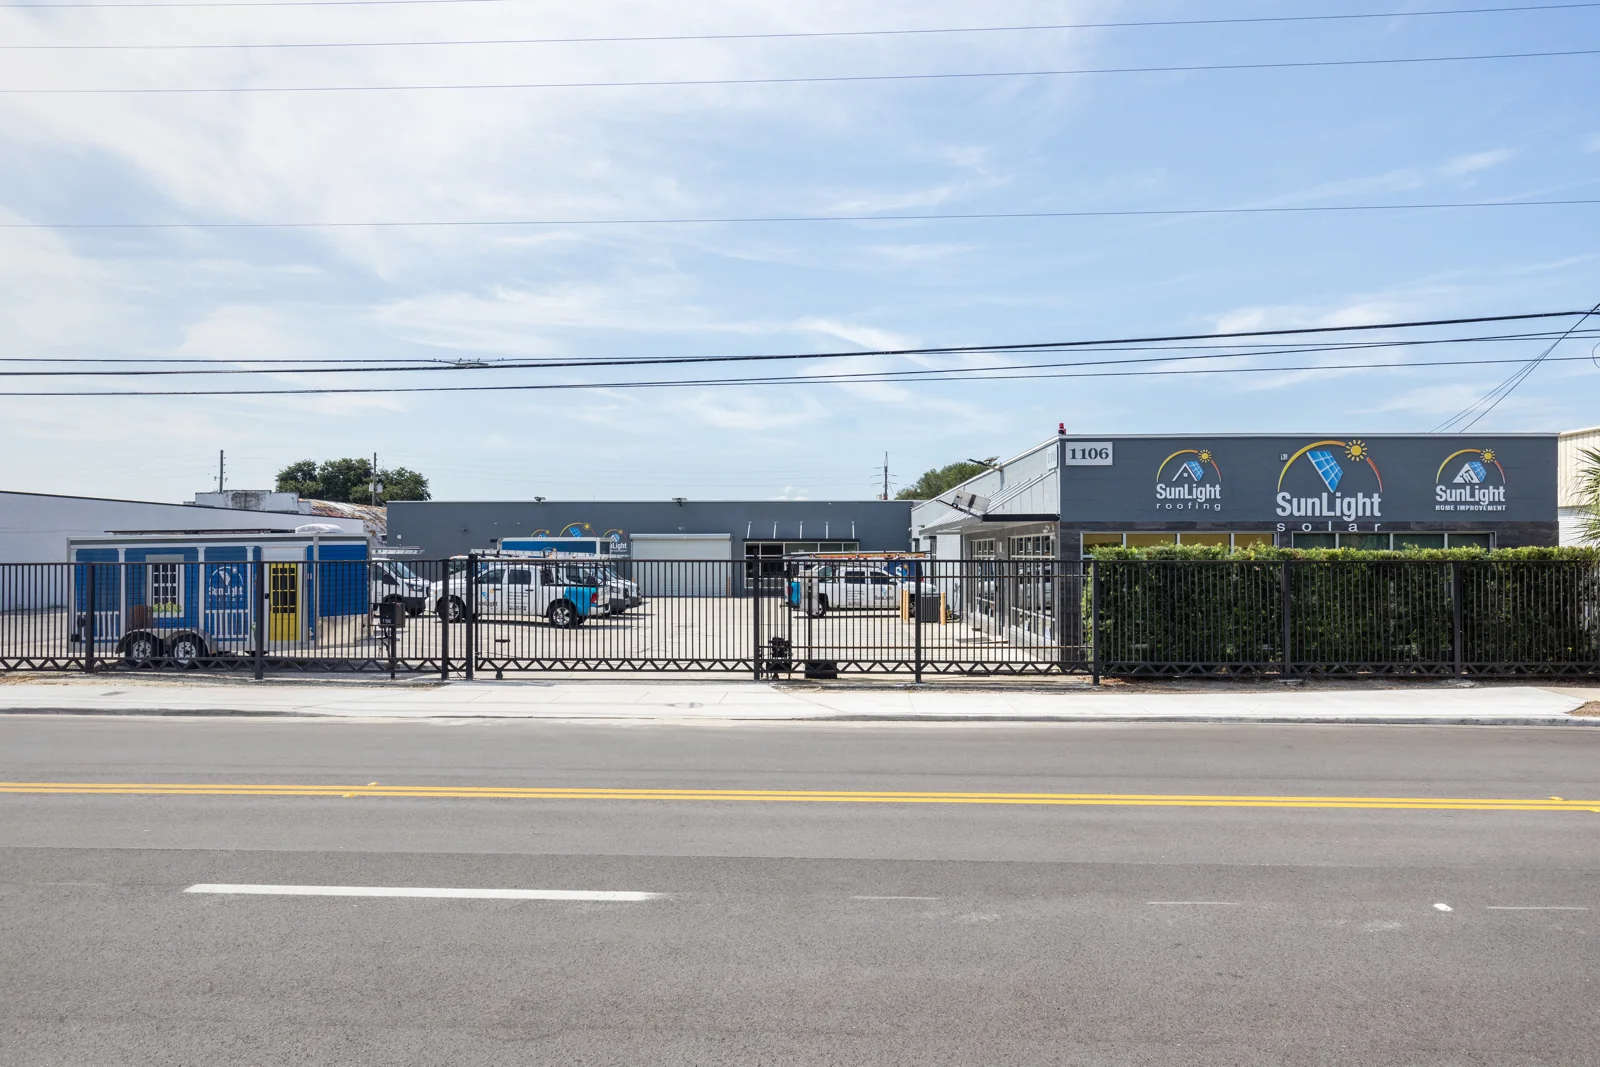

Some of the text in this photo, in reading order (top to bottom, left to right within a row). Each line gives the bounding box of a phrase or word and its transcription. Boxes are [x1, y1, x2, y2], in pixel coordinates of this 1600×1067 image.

[1069, 447, 1109, 460] 1106
[1155, 483, 1222, 503] SunLight
[1435, 484, 1506, 505] SunLight
[1156, 501, 1222, 512] roofing
[1275, 491, 1382, 521] SunLight
[1276, 520, 1382, 532] solar
